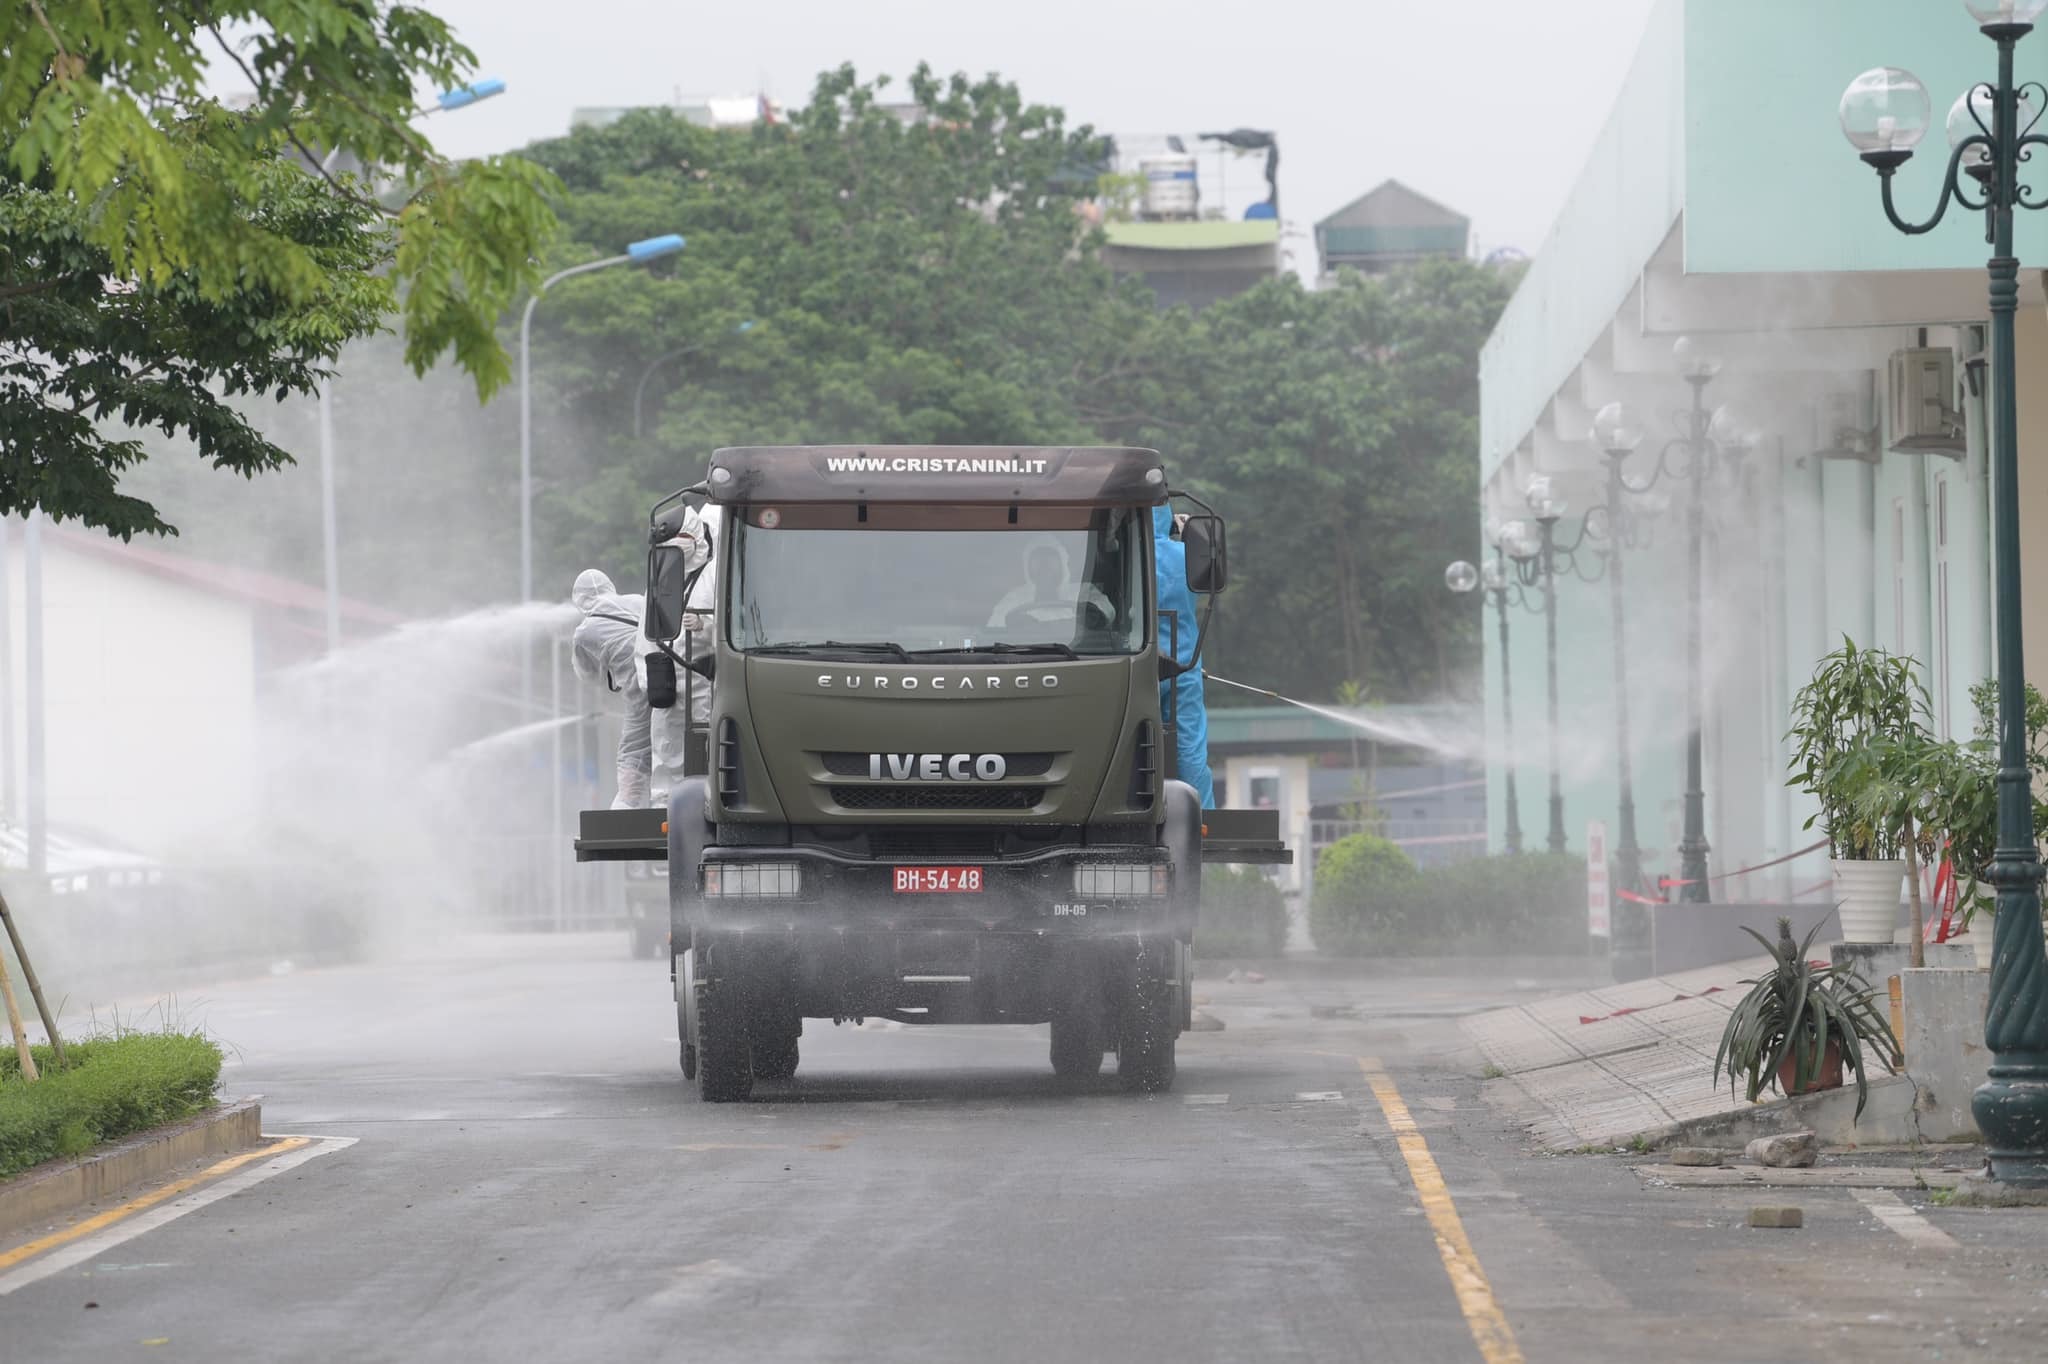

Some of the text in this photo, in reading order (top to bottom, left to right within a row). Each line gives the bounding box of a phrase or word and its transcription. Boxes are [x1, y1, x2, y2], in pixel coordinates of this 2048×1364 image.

[827, 458, 1047, 473] WWW.CRISTANINI.IT
[817, 674, 1059, 690] EUROCARGO
[869, 753, 1007, 781] IVECO
[897, 870, 980, 890] BH-54-48
[1054, 904, 1087, 916] DH-05
